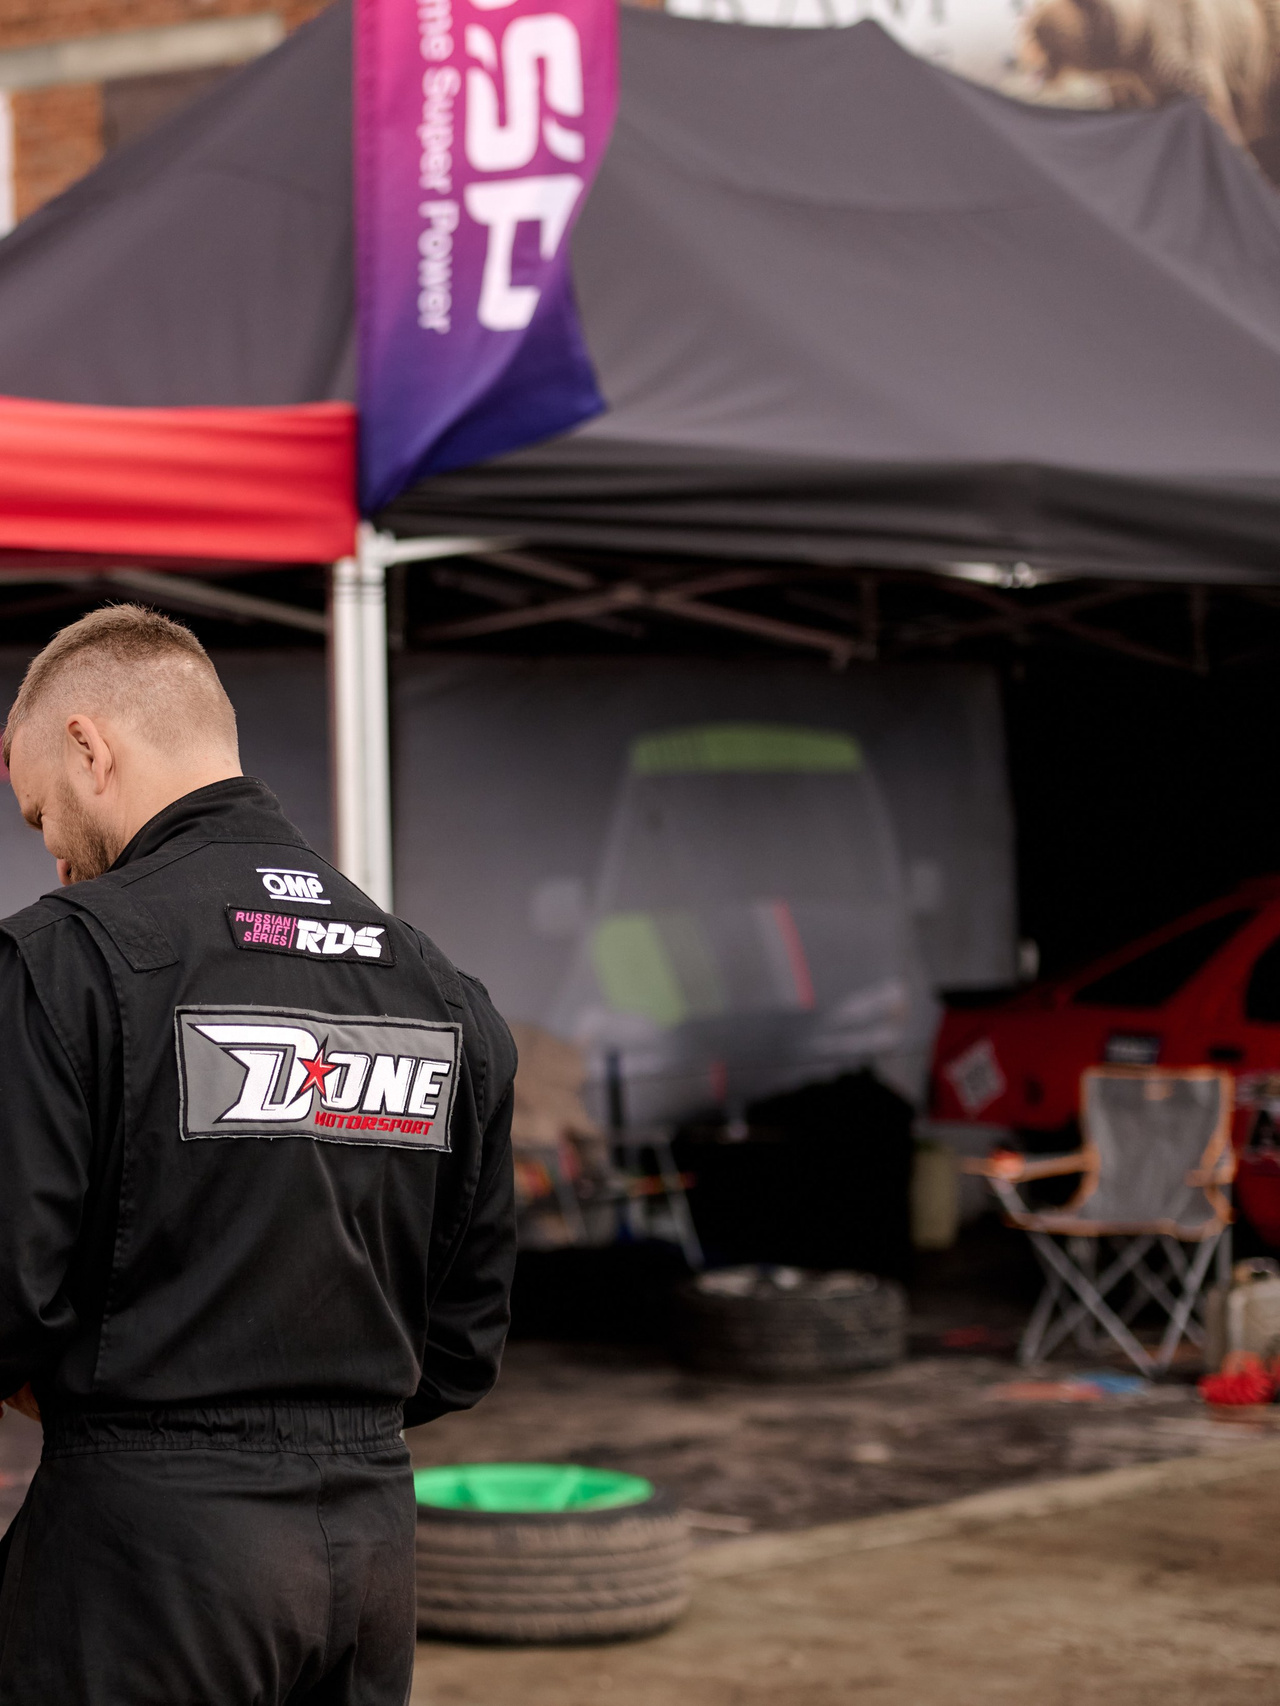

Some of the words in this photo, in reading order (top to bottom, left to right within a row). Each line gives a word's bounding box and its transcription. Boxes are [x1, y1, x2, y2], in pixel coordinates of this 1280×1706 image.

[417, 66, 460, 194] Super
[417, 200, 459, 334] Power
[261, 872, 324, 900] OMP
[235, 911, 292, 927] RUSSIAN
[253, 922, 291, 936] DRIFT
[243, 931, 288, 947] SERIES
[295, 918, 386, 958] RDS
[314, 1110, 434, 1137] MOTORSPORT
